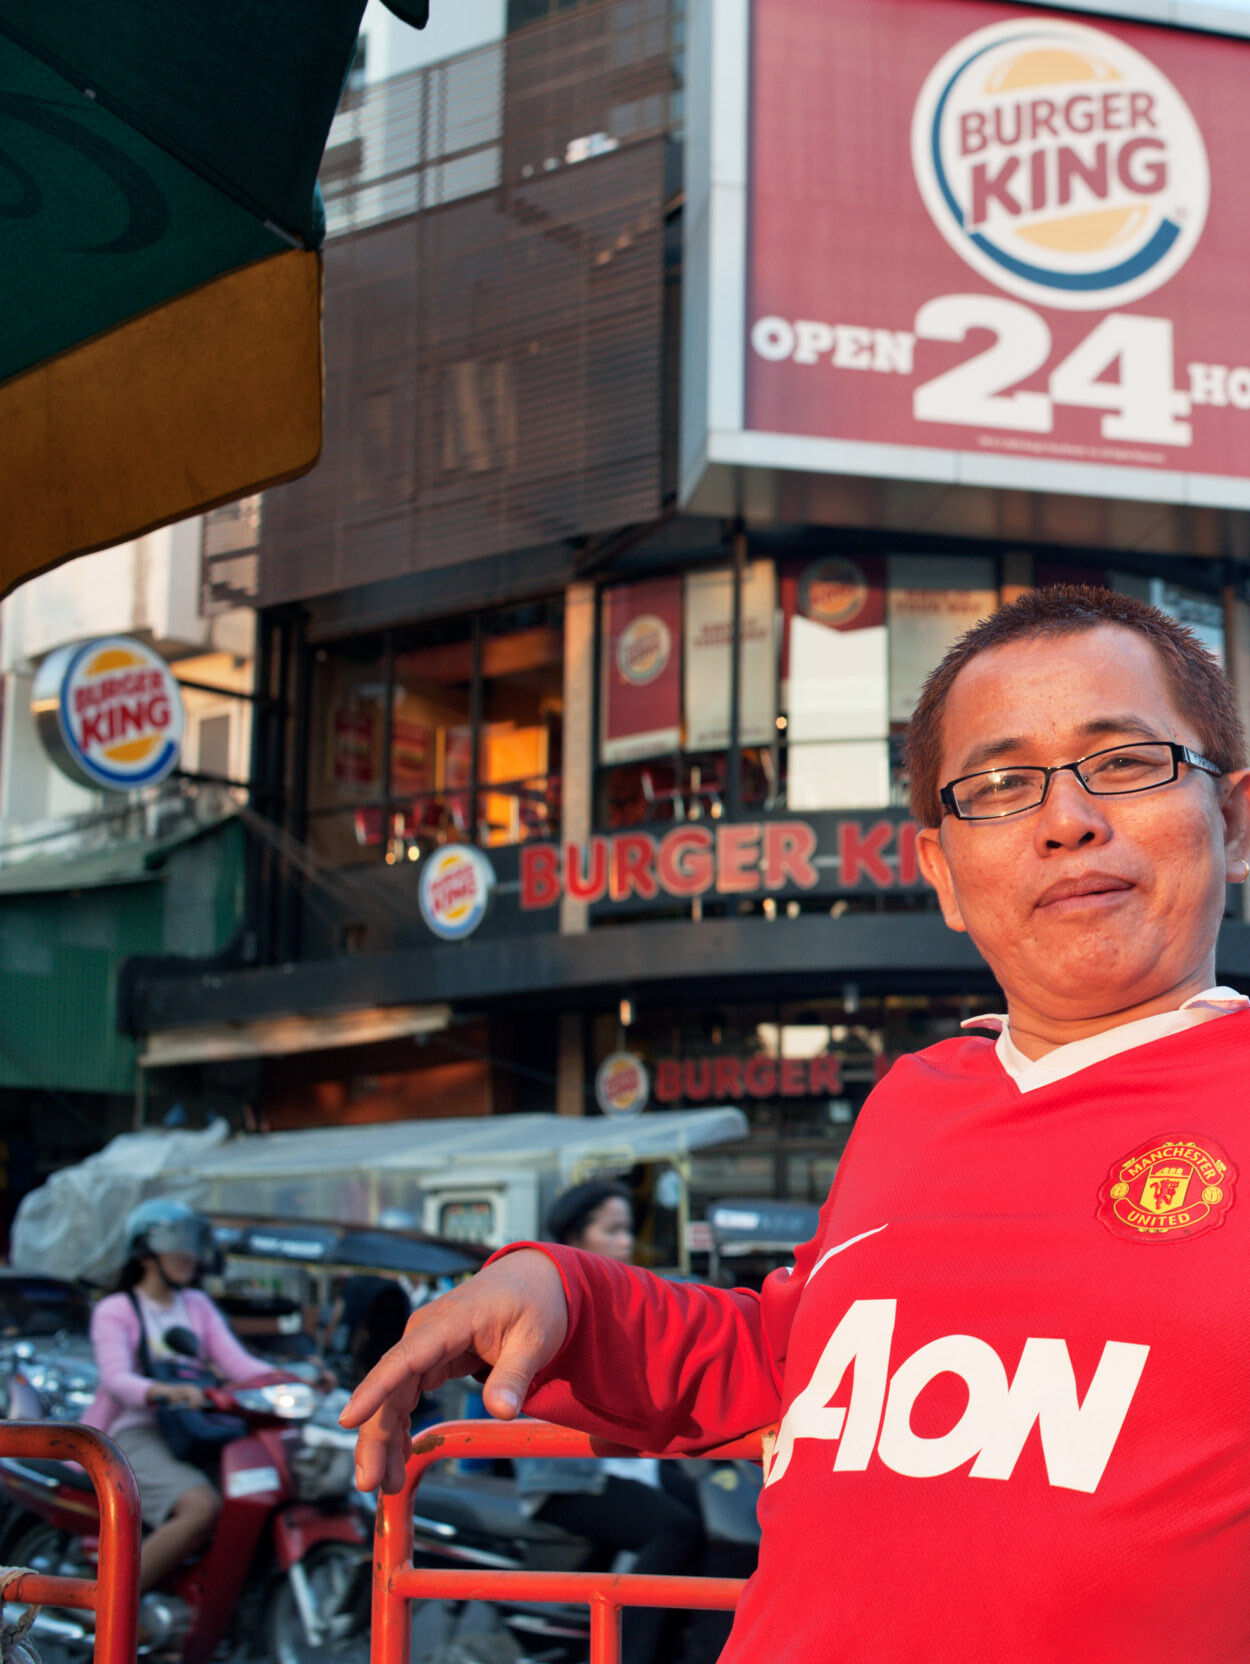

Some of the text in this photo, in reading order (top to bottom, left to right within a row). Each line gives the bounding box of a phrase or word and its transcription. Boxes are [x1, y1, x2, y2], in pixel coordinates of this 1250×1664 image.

[959, 90, 1157, 158] BURGER
[970, 136, 1168, 226] KING
[751, 315, 918, 376] OPEN
[912, 293, 1192, 447] 24
[74, 668, 165, 712] BURGER
[80, 696, 172, 755] KING
[518, 821, 820, 911] BURGER
[654, 1053, 843, 1102] BURGER
[1127, 1147, 1218, 1180] MANCHESTER
[1126, 1209, 1192, 1228] UNITED
[764, 1298, 1151, 1494] AON
